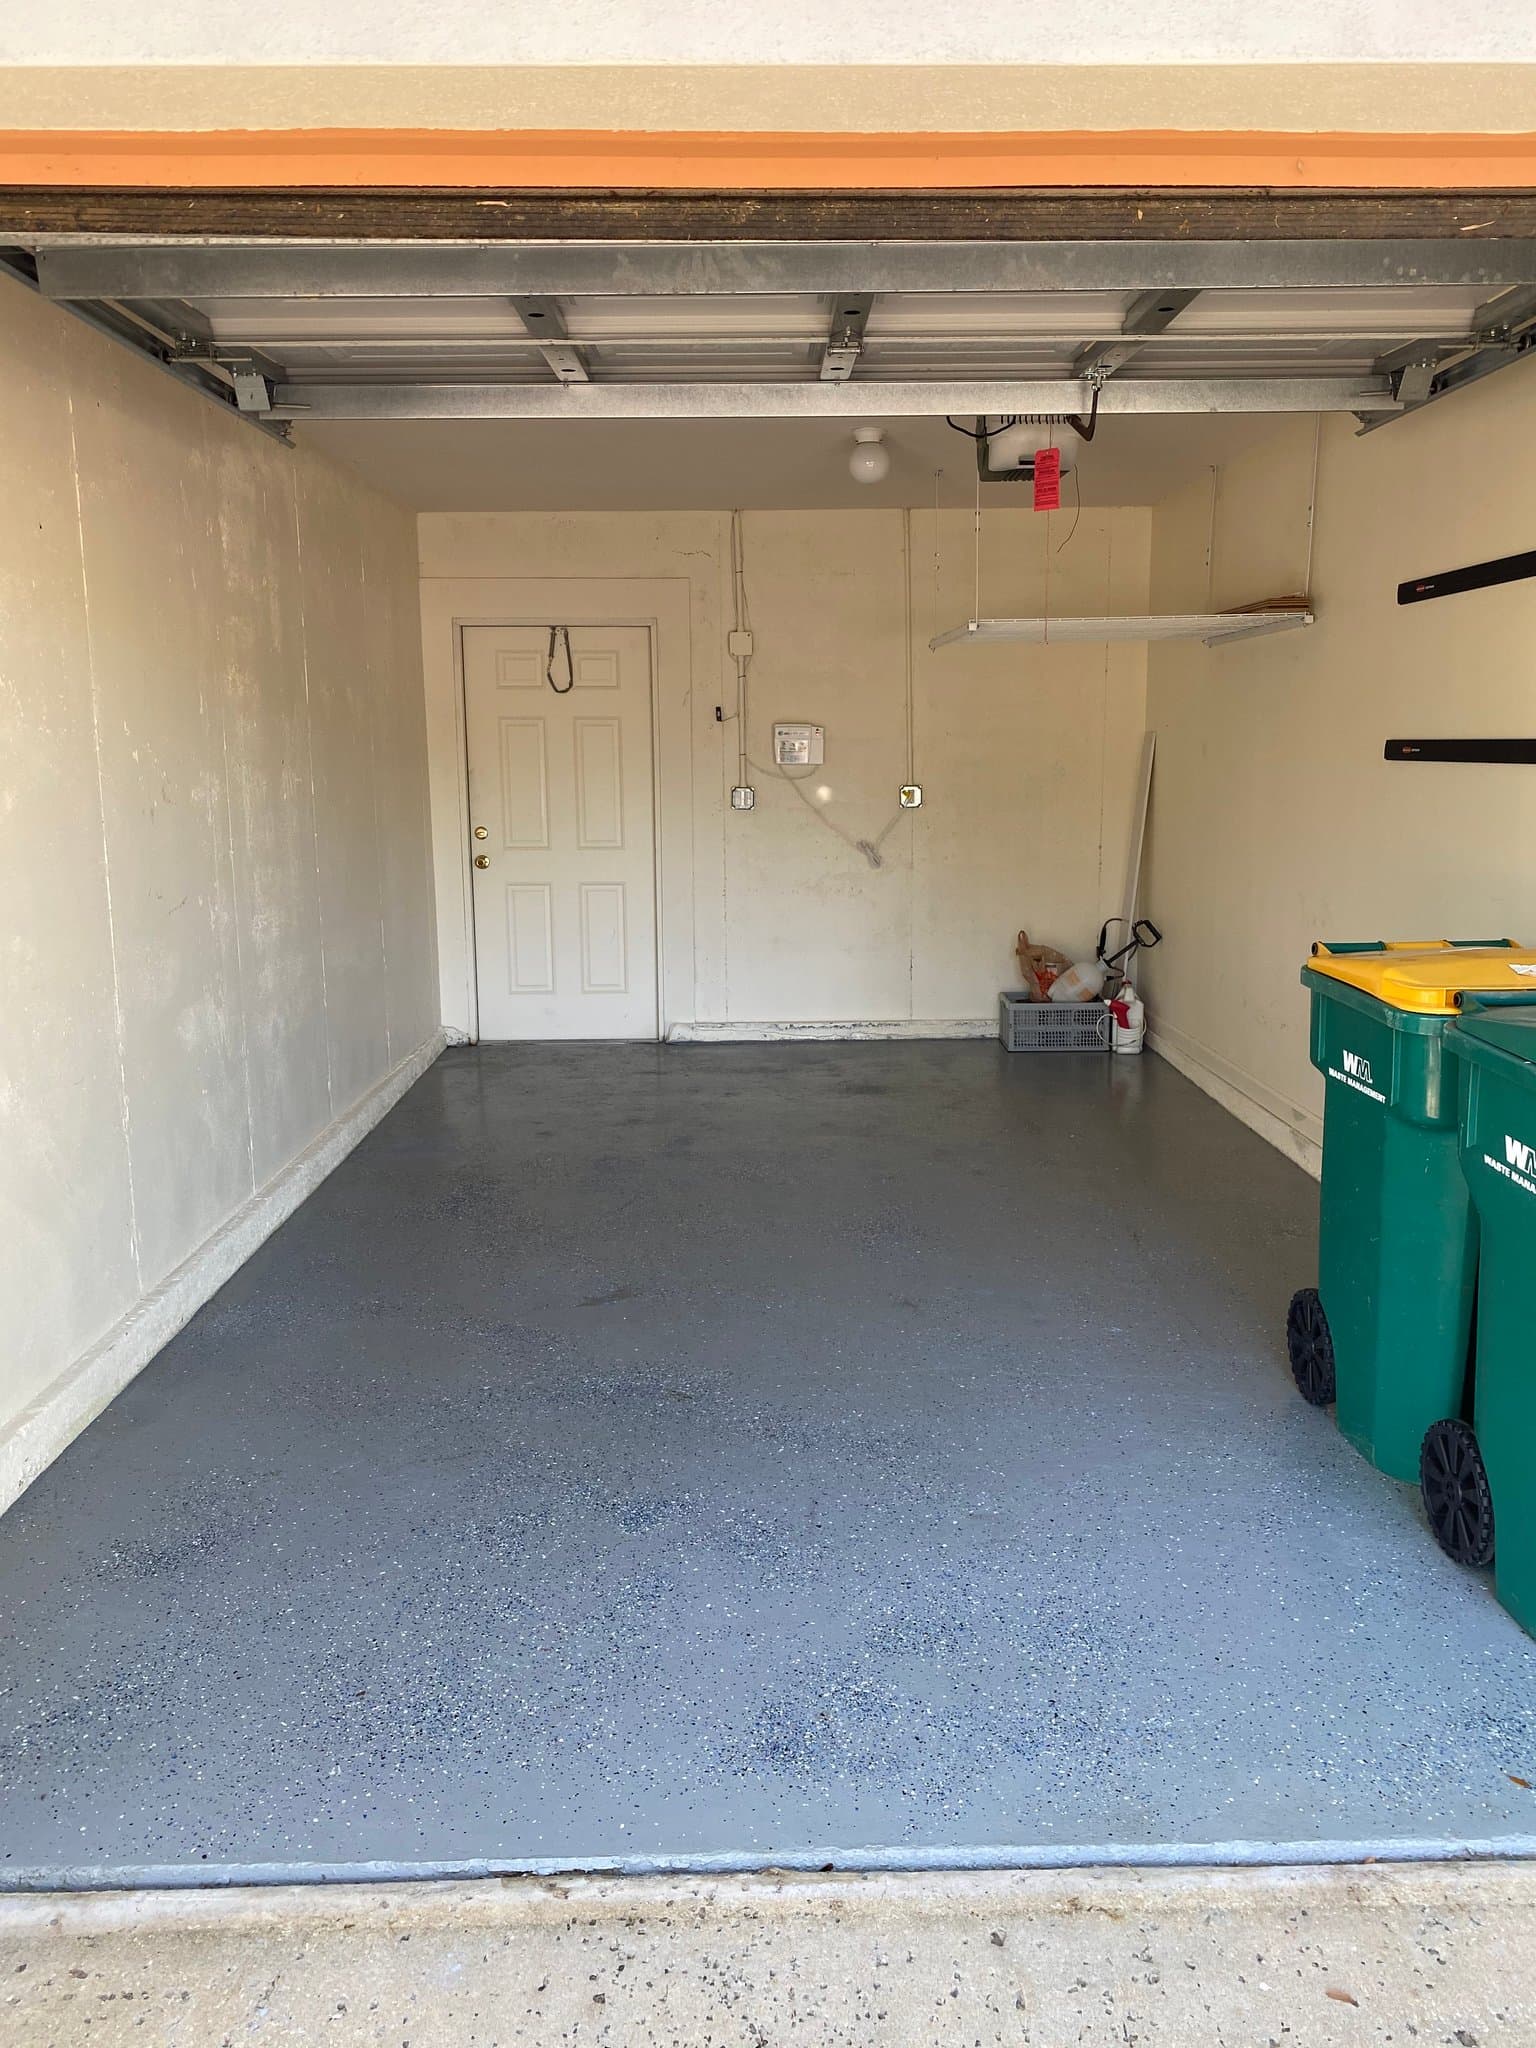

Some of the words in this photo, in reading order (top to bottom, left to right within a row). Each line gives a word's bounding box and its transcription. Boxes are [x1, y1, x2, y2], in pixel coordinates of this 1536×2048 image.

[1343, 1049, 1373, 1084] WM
[1328, 1066, 1347, 1083] WASTE
[1347, 1077, 1386, 1104] MANAGEMENT
[1483, 1153, 1511, 1178] WASTE
